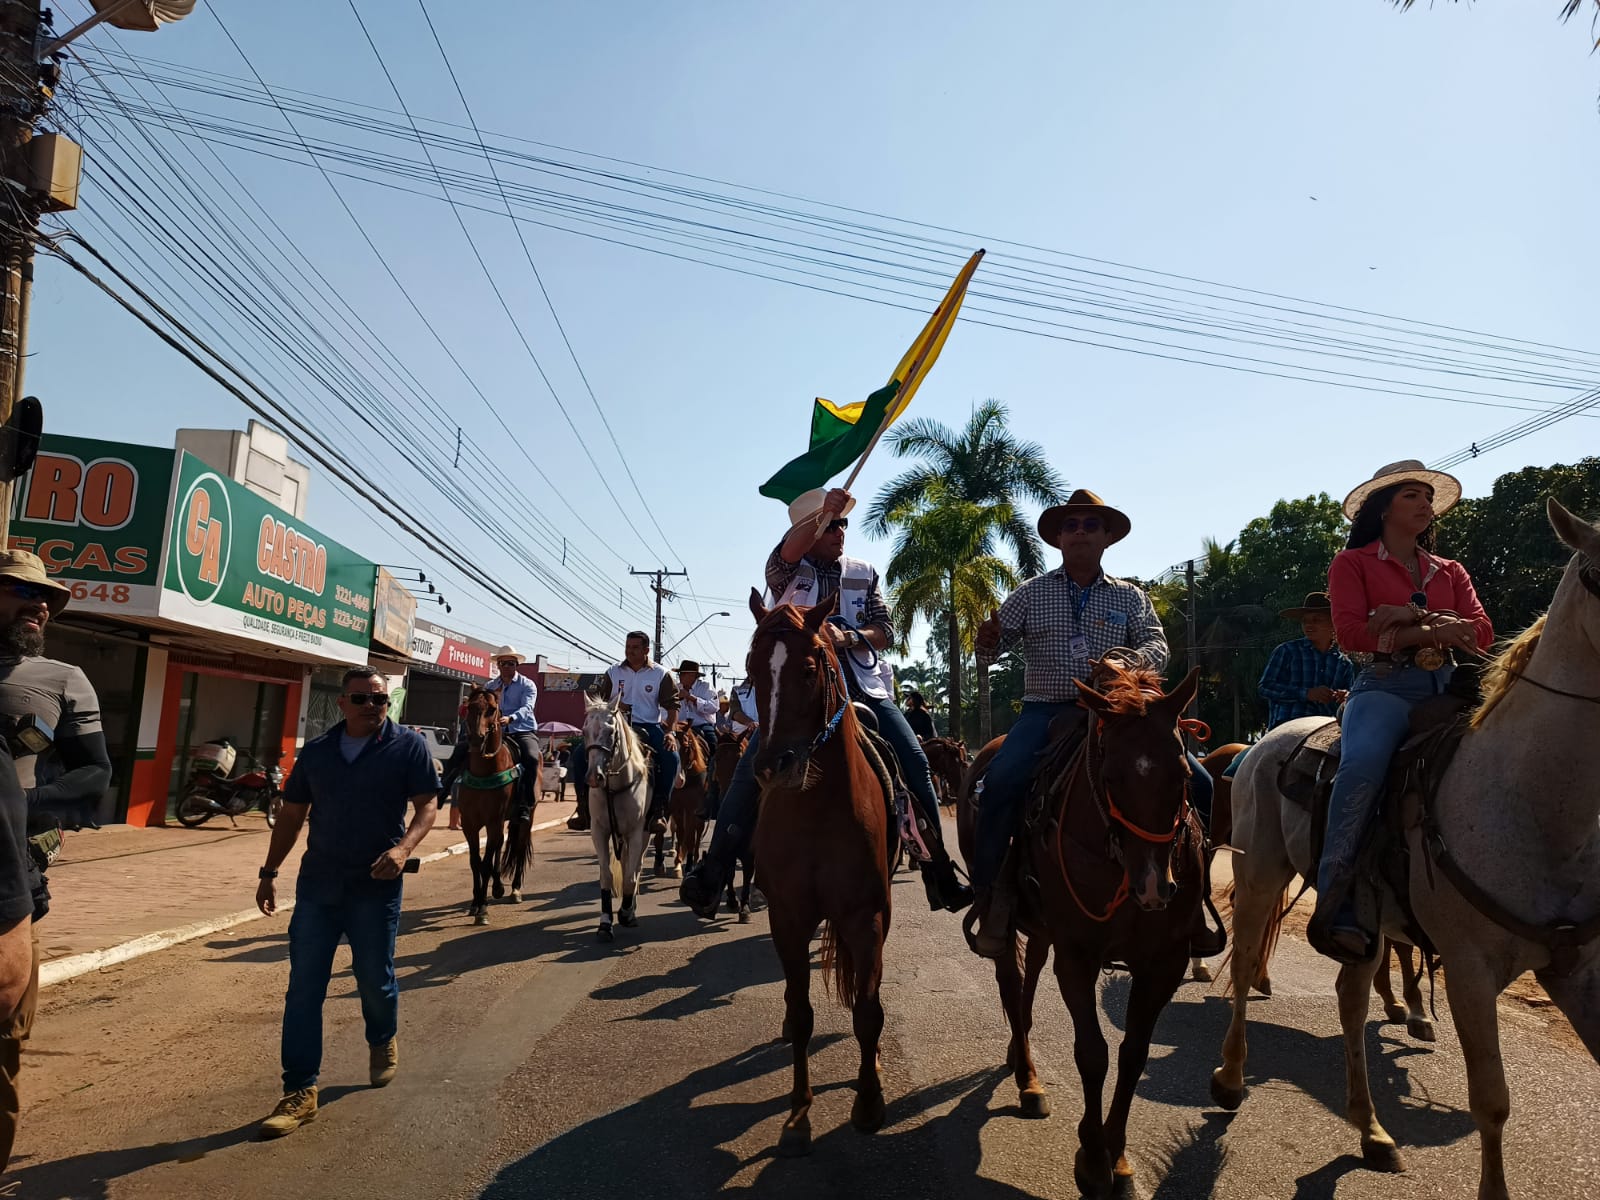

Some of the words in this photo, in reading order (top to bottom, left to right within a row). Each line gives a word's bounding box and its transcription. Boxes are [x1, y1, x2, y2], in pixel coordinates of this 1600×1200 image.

[11, 451, 139, 531] RO
[186, 488, 222, 585] CA
[257, 514, 327, 596] CASTRO
[57, 580, 130, 603] 648
[242, 582, 285, 615] AUTO
[287, 597, 327, 629] PEÇAS
[448, 645, 484, 669] Firestone
